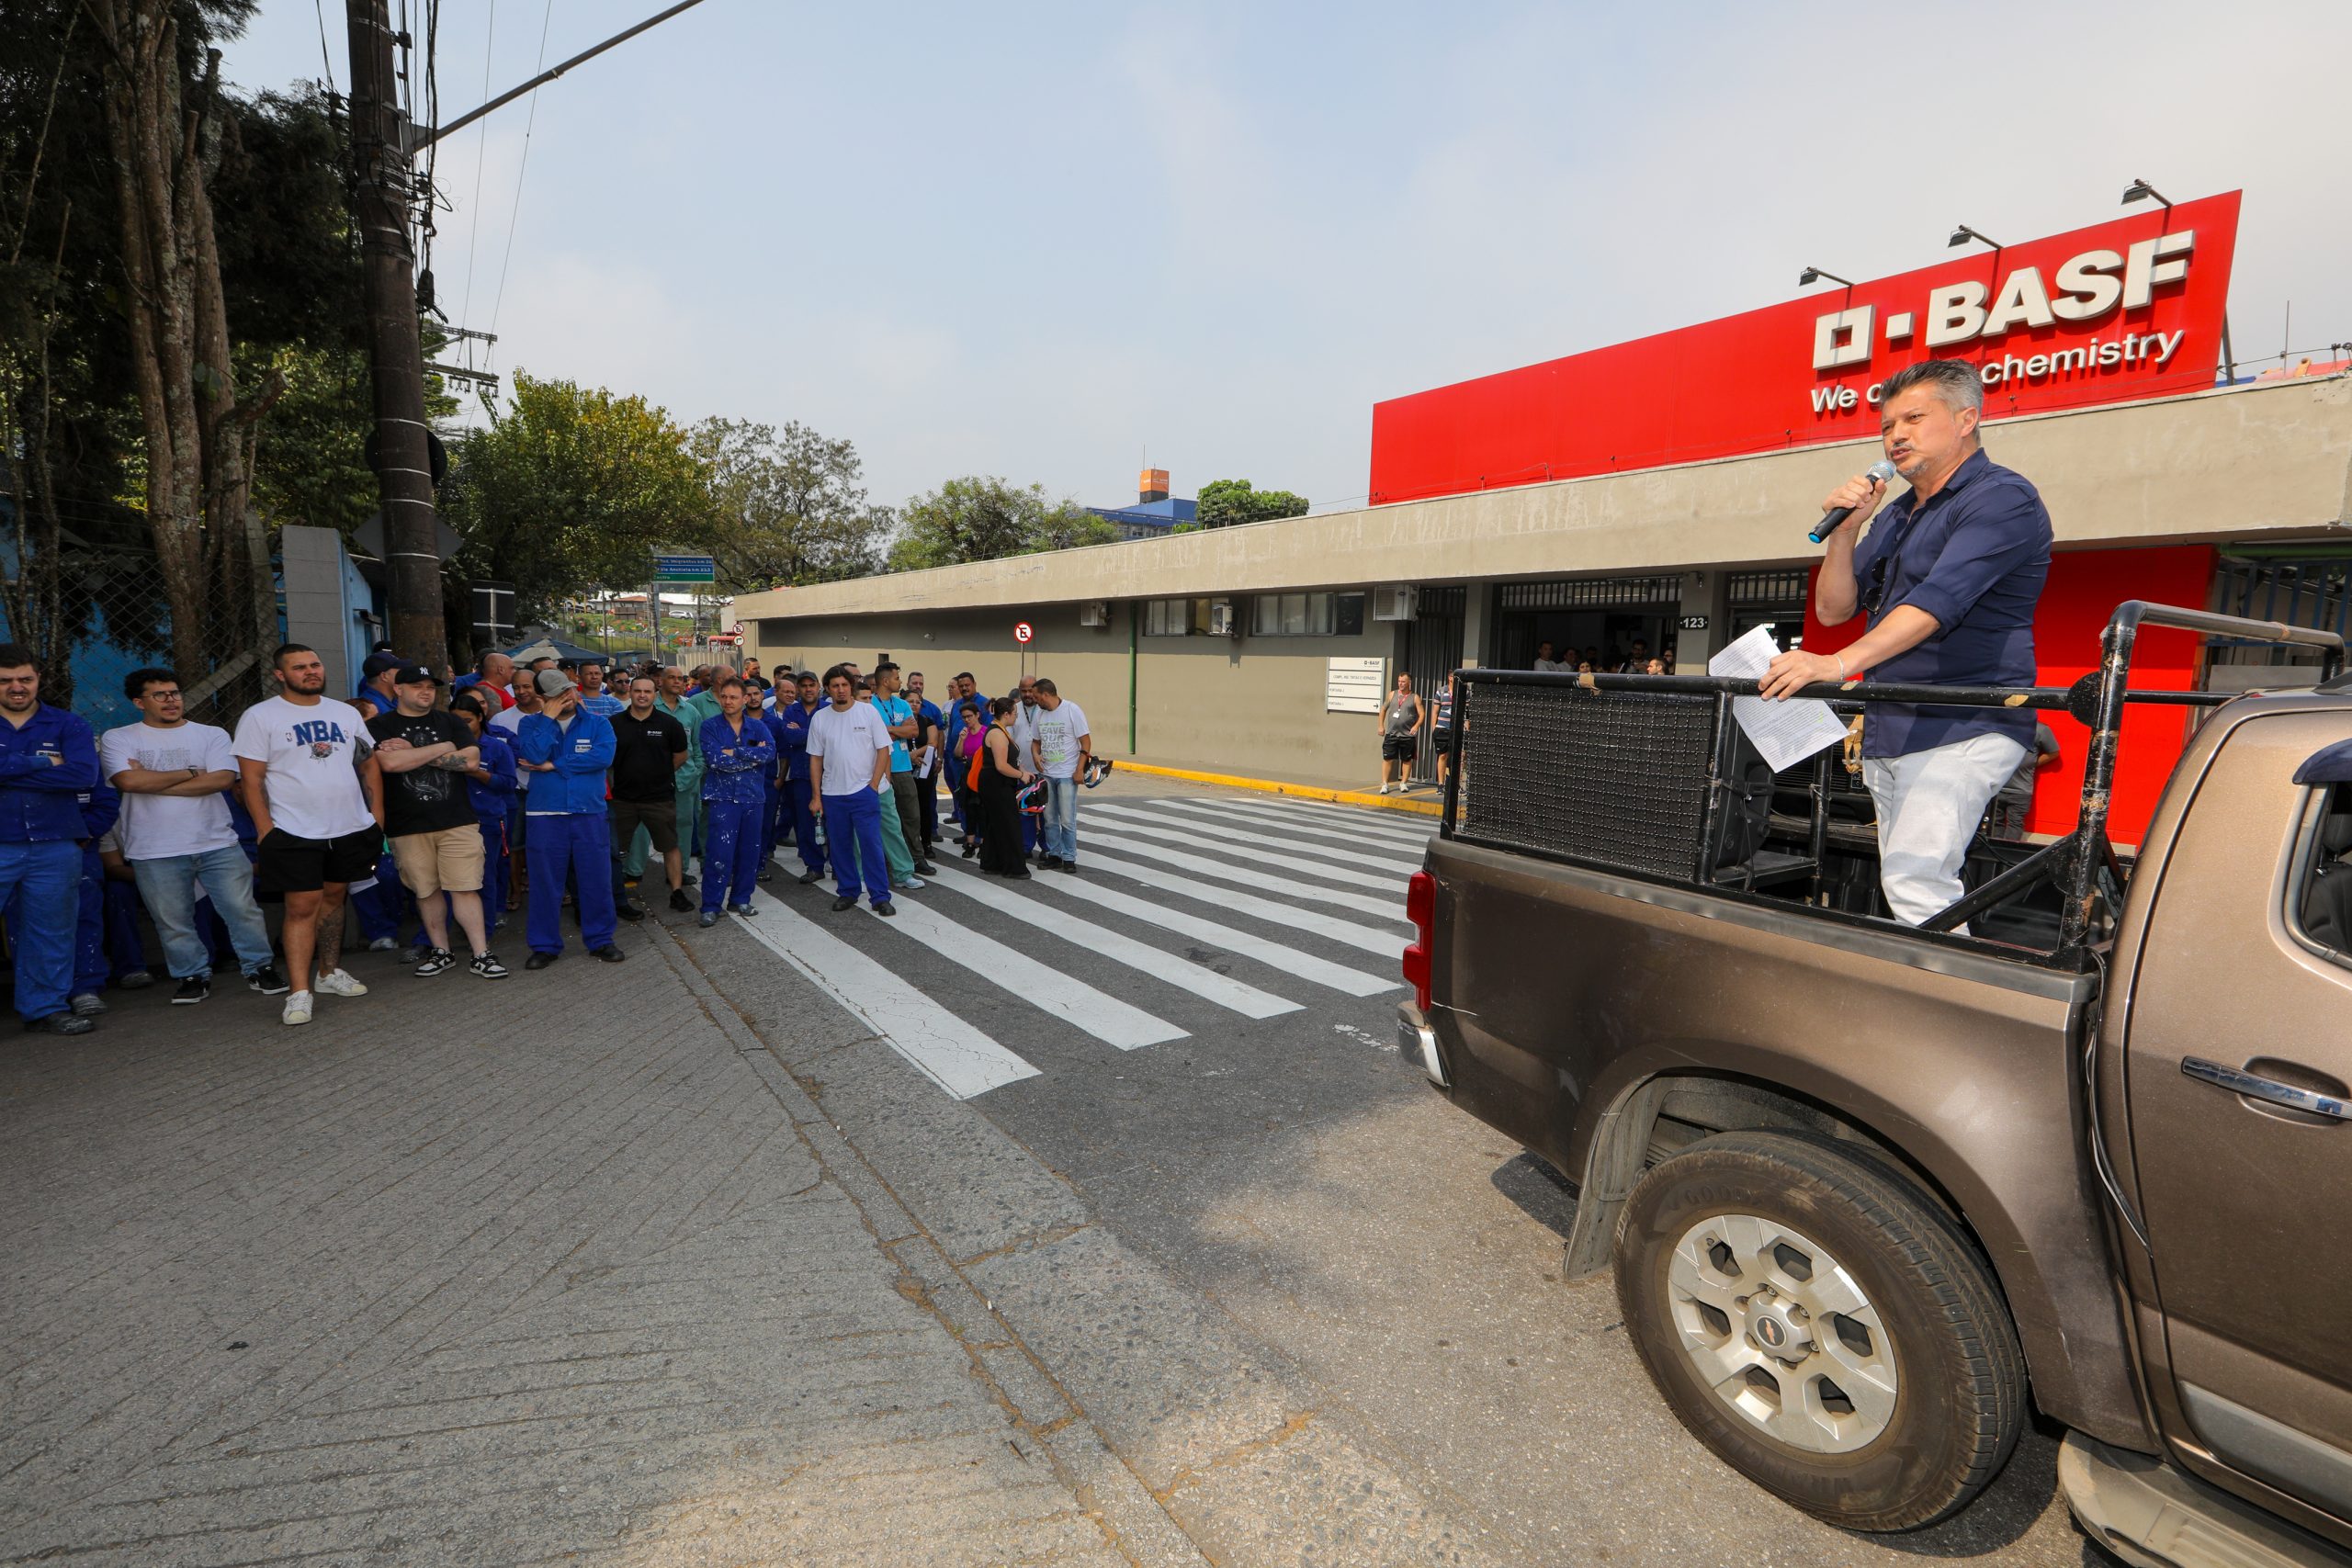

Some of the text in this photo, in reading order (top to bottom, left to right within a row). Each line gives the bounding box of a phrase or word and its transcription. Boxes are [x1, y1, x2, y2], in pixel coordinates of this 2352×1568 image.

[1926, 229, 2196, 347] BASF
[1811, 384, 1859, 412] We
[1981, 330, 2185, 385] chemistry
[1683, 617, 1704, 628] 123
[292, 720, 346, 747] NBA
